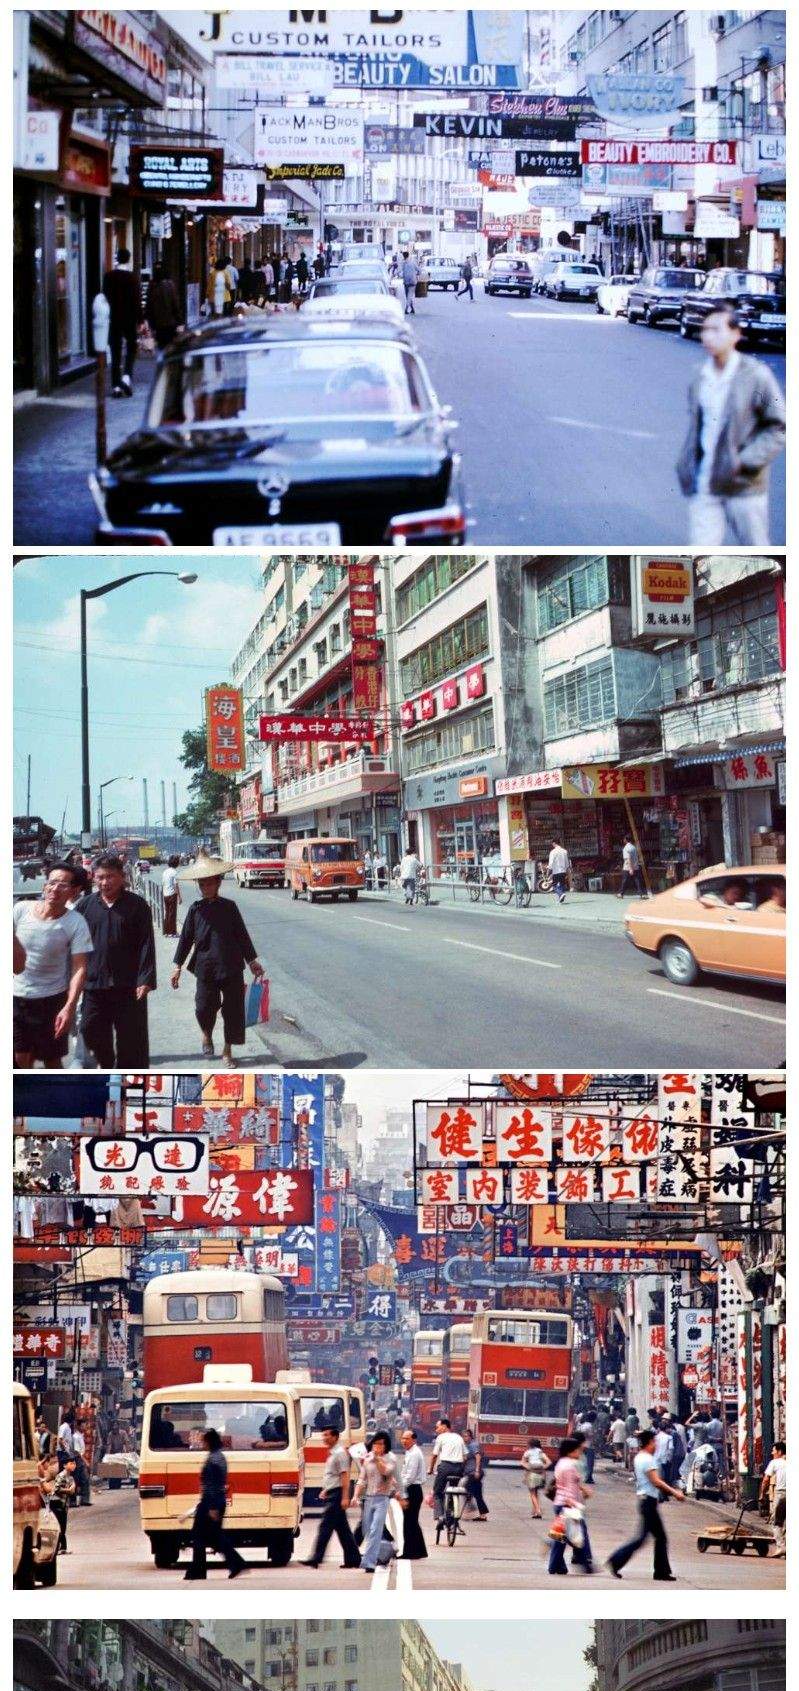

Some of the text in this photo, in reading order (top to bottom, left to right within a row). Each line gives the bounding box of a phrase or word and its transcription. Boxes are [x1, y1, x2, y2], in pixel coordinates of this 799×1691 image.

[231, 31, 442, 48] CUSTOM TAILORS
[334, 62, 497, 87] BEAUTY SALON
[425, 115, 503, 136] KEVIN
[267, 137, 357, 146] CUSTOM TAILORS
[520, 152, 574, 168] Petone's
[588, 142, 734, 164] BEAUTY EMBROIDERY CO.
[648, 576, 687, 589] Kodak
